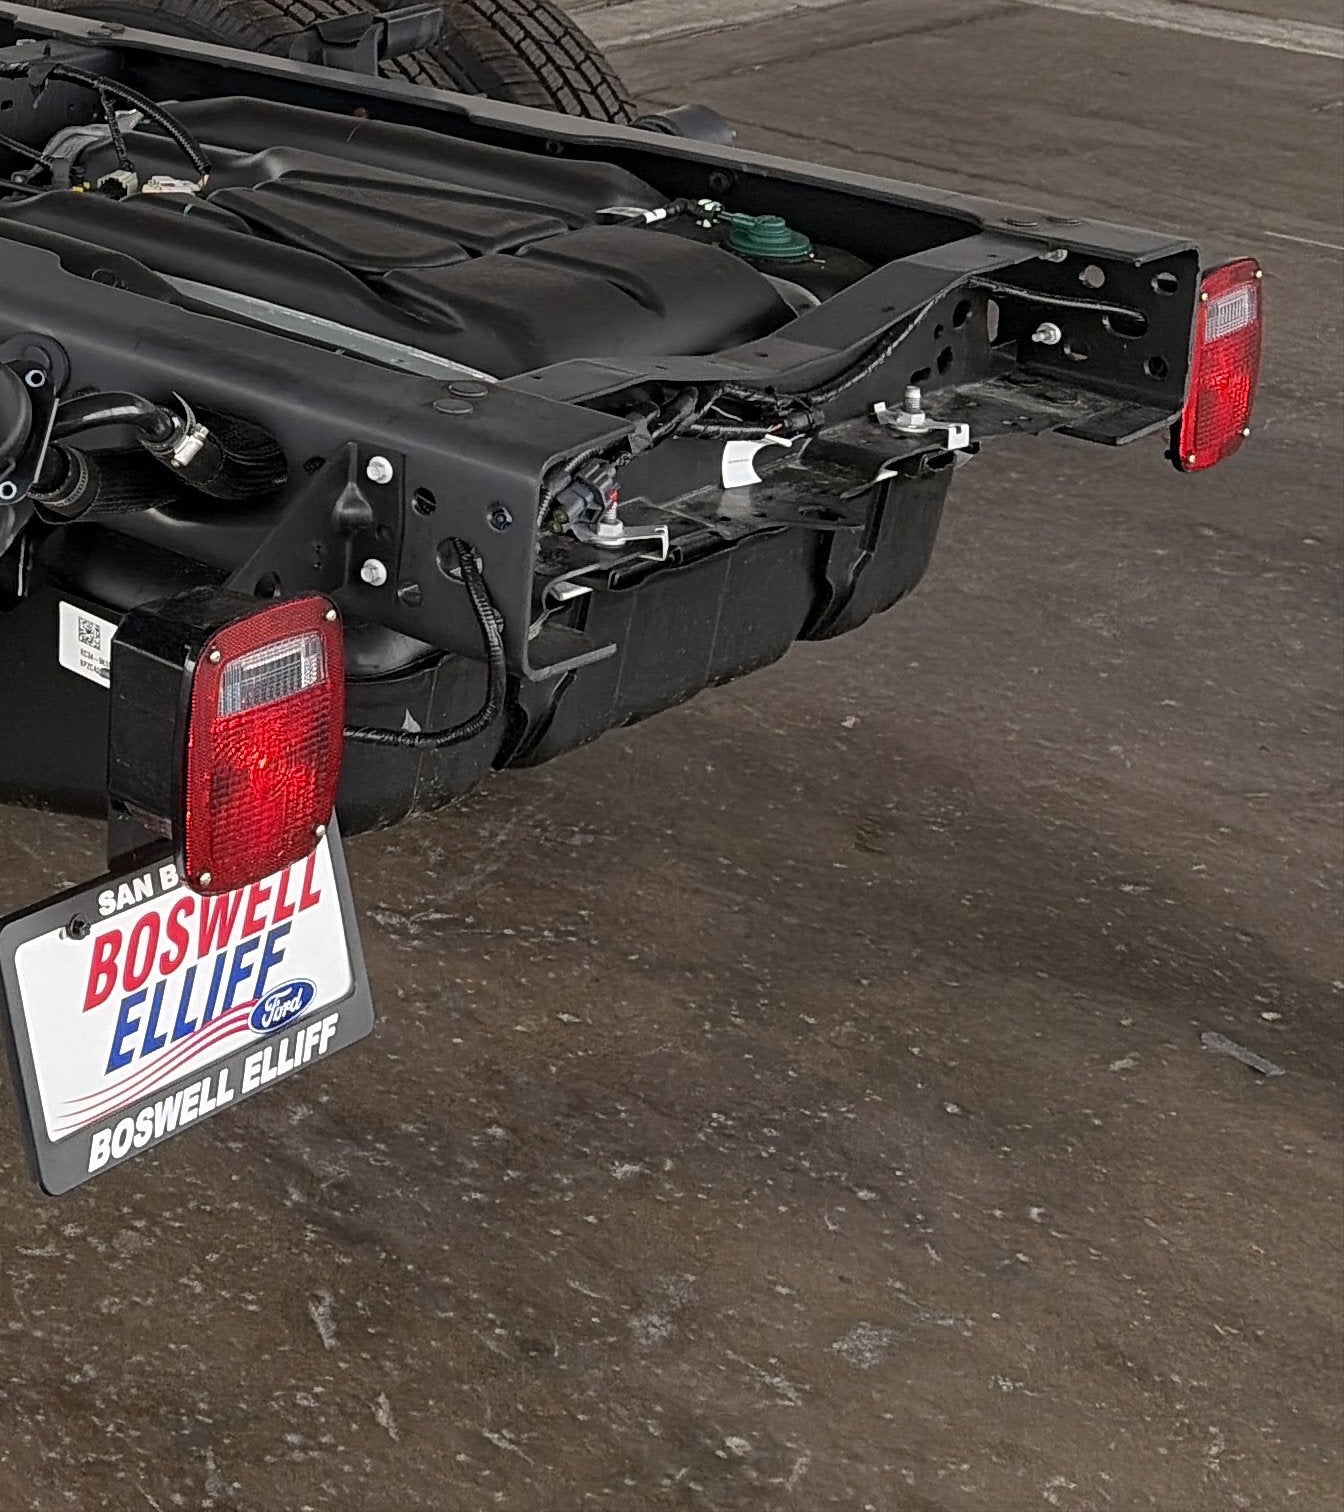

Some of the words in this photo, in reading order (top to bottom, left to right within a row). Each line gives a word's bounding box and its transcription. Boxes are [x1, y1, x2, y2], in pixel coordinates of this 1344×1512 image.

[83, 852, 322, 1013] BOSWELL
[97, 873, 154, 917] SAN
[104, 920, 292, 1077] ELLIFF
[262, 985, 303, 1028] Ford
[88, 1068, 235, 1174] BOSWELL
[241, 1012, 339, 1093] ELLIFF
